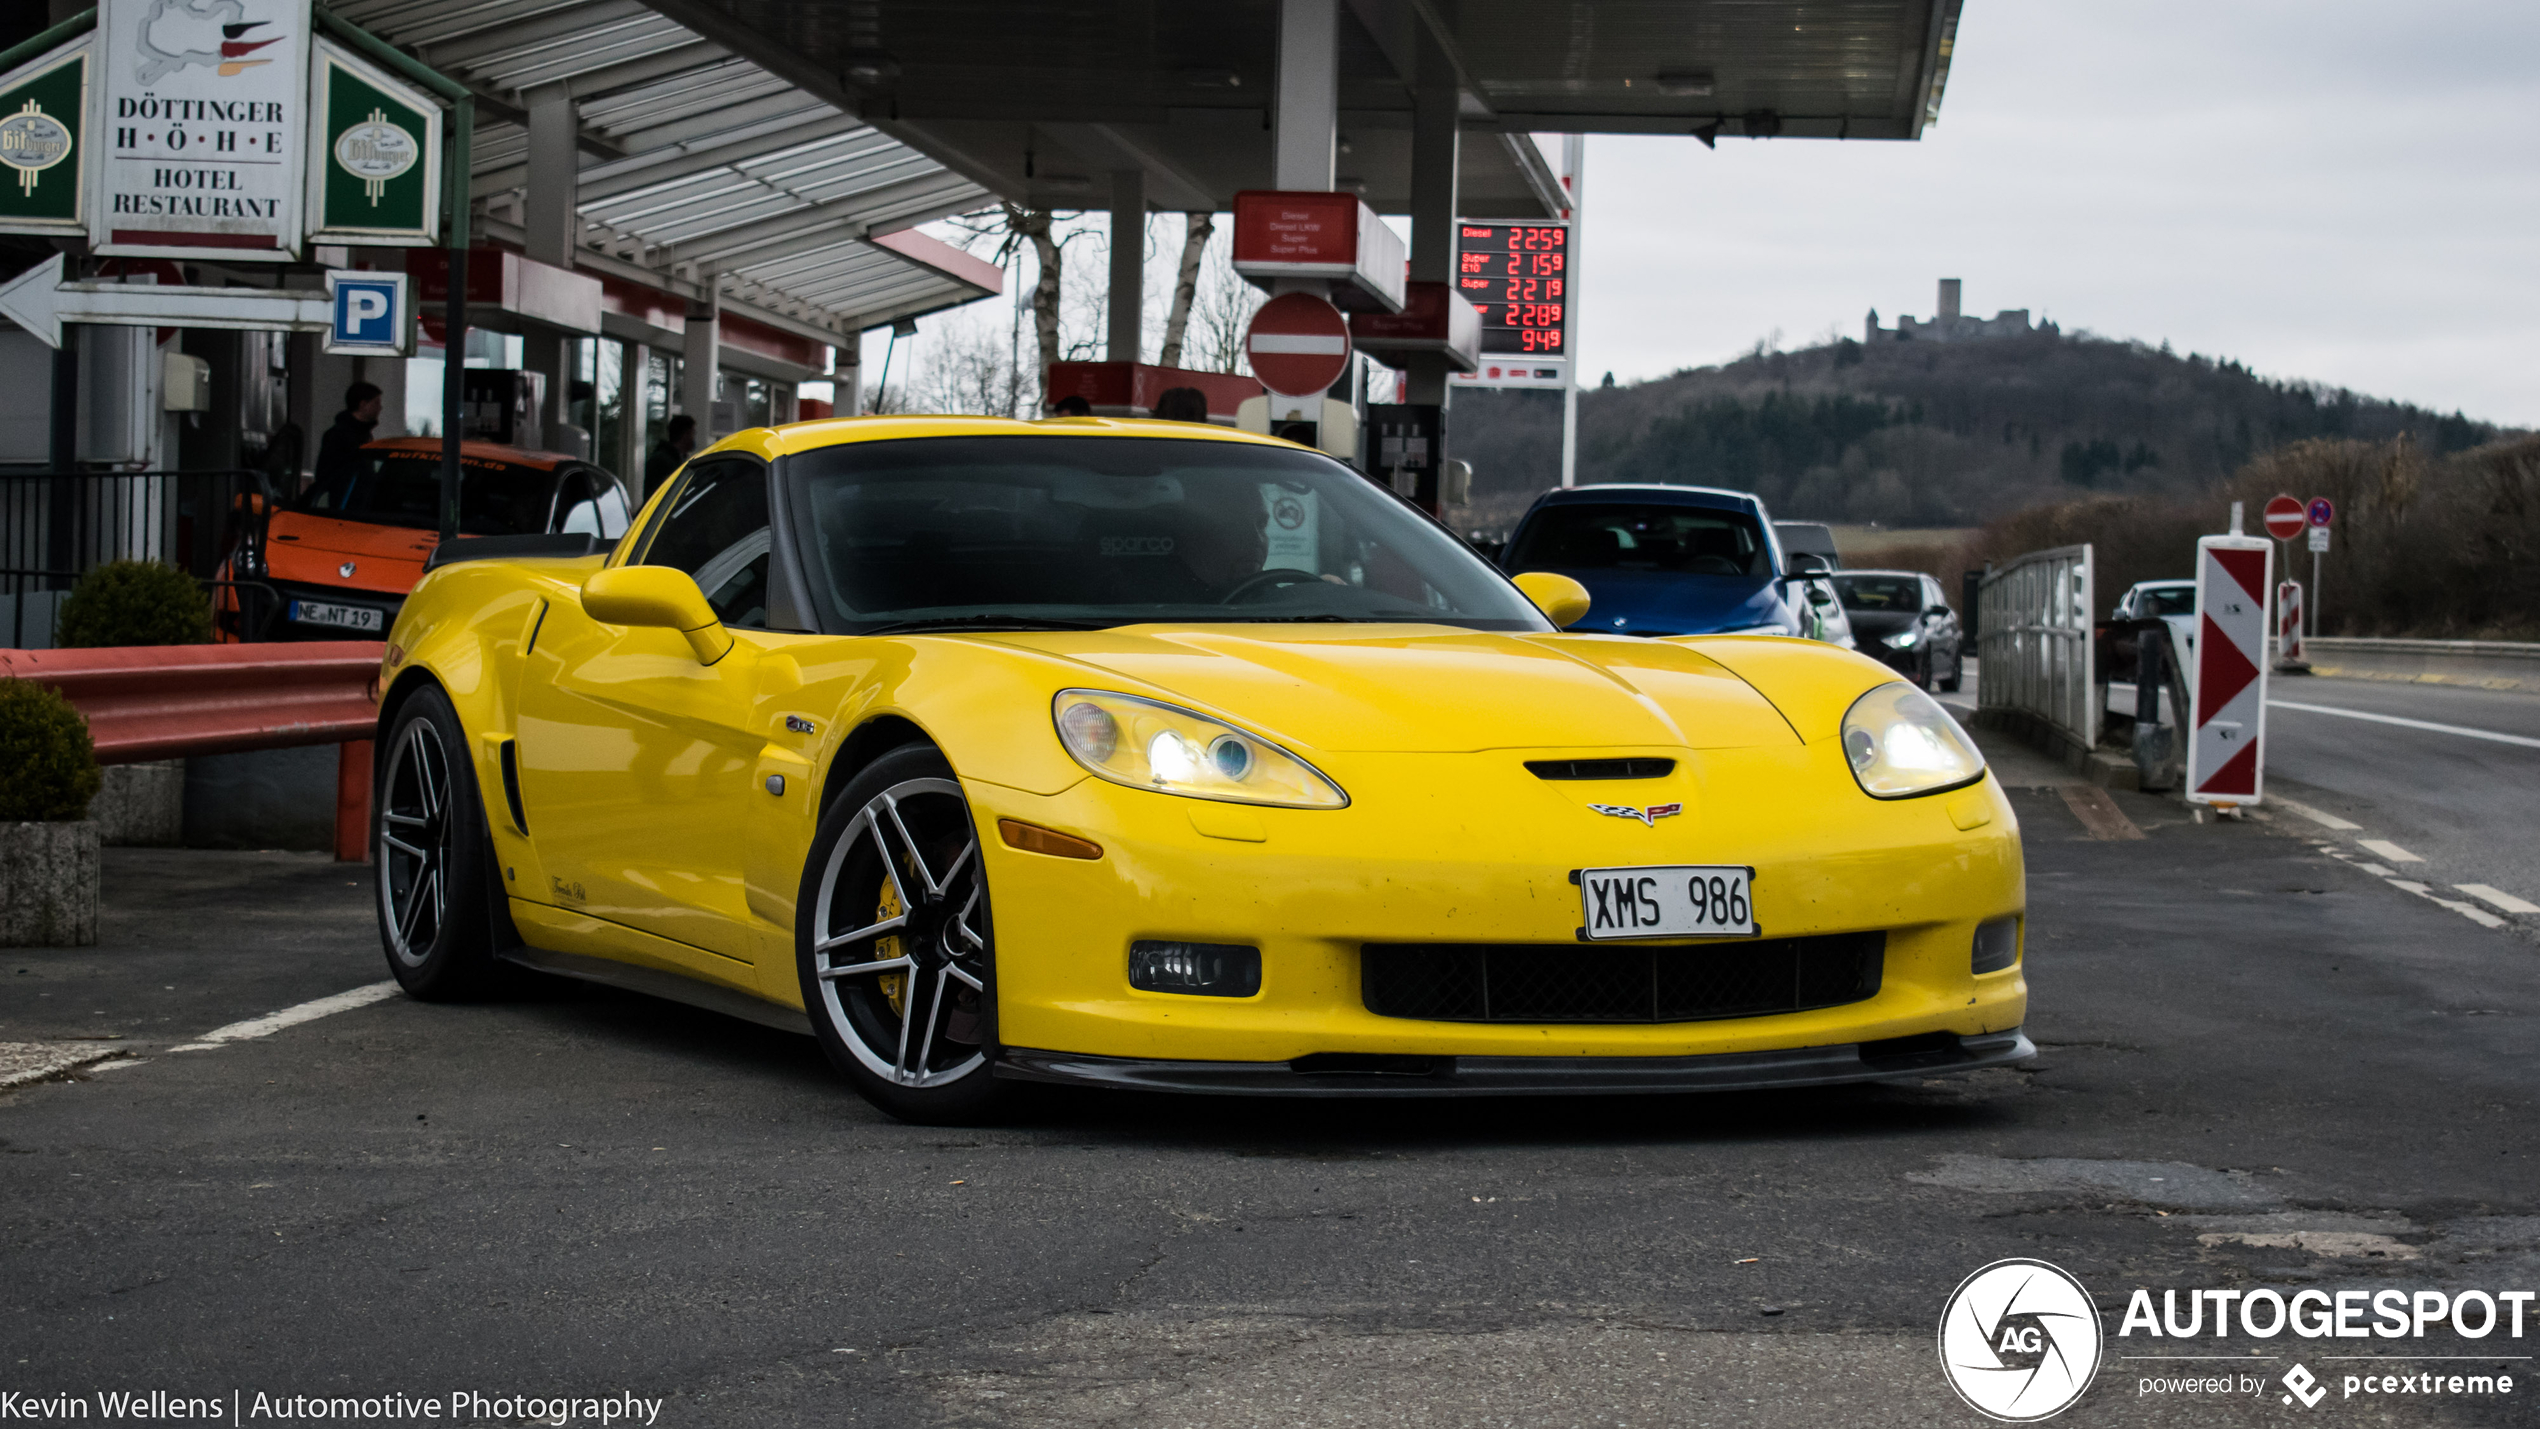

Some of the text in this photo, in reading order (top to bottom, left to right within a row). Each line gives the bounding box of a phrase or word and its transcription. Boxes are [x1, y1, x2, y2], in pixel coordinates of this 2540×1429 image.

[118, 91, 283, 123] DÖTTINGER
[154, 168, 243, 191] HOTEL
[113, 193, 281, 219] RESTAURANT
[1270, 222, 1297, 231] Diesel
[1462, 226, 1492, 238] Diesel
[1281, 233, 1309, 243] Super
[1270, 244, 1318, 255] Super Plus
[1461, 252, 1491, 264] Super
[1461, 262, 1481, 273] E10
[1461, 277, 1490, 290] Super
[346, 289, 388, 335] P
[1522, 329, 1561, 352] 949
[299, 603, 318, 620] NE
[328, 607, 348, 624] NT
[351, 610, 371, 627] 19
[1590, 875, 1748, 929] XMS 986
